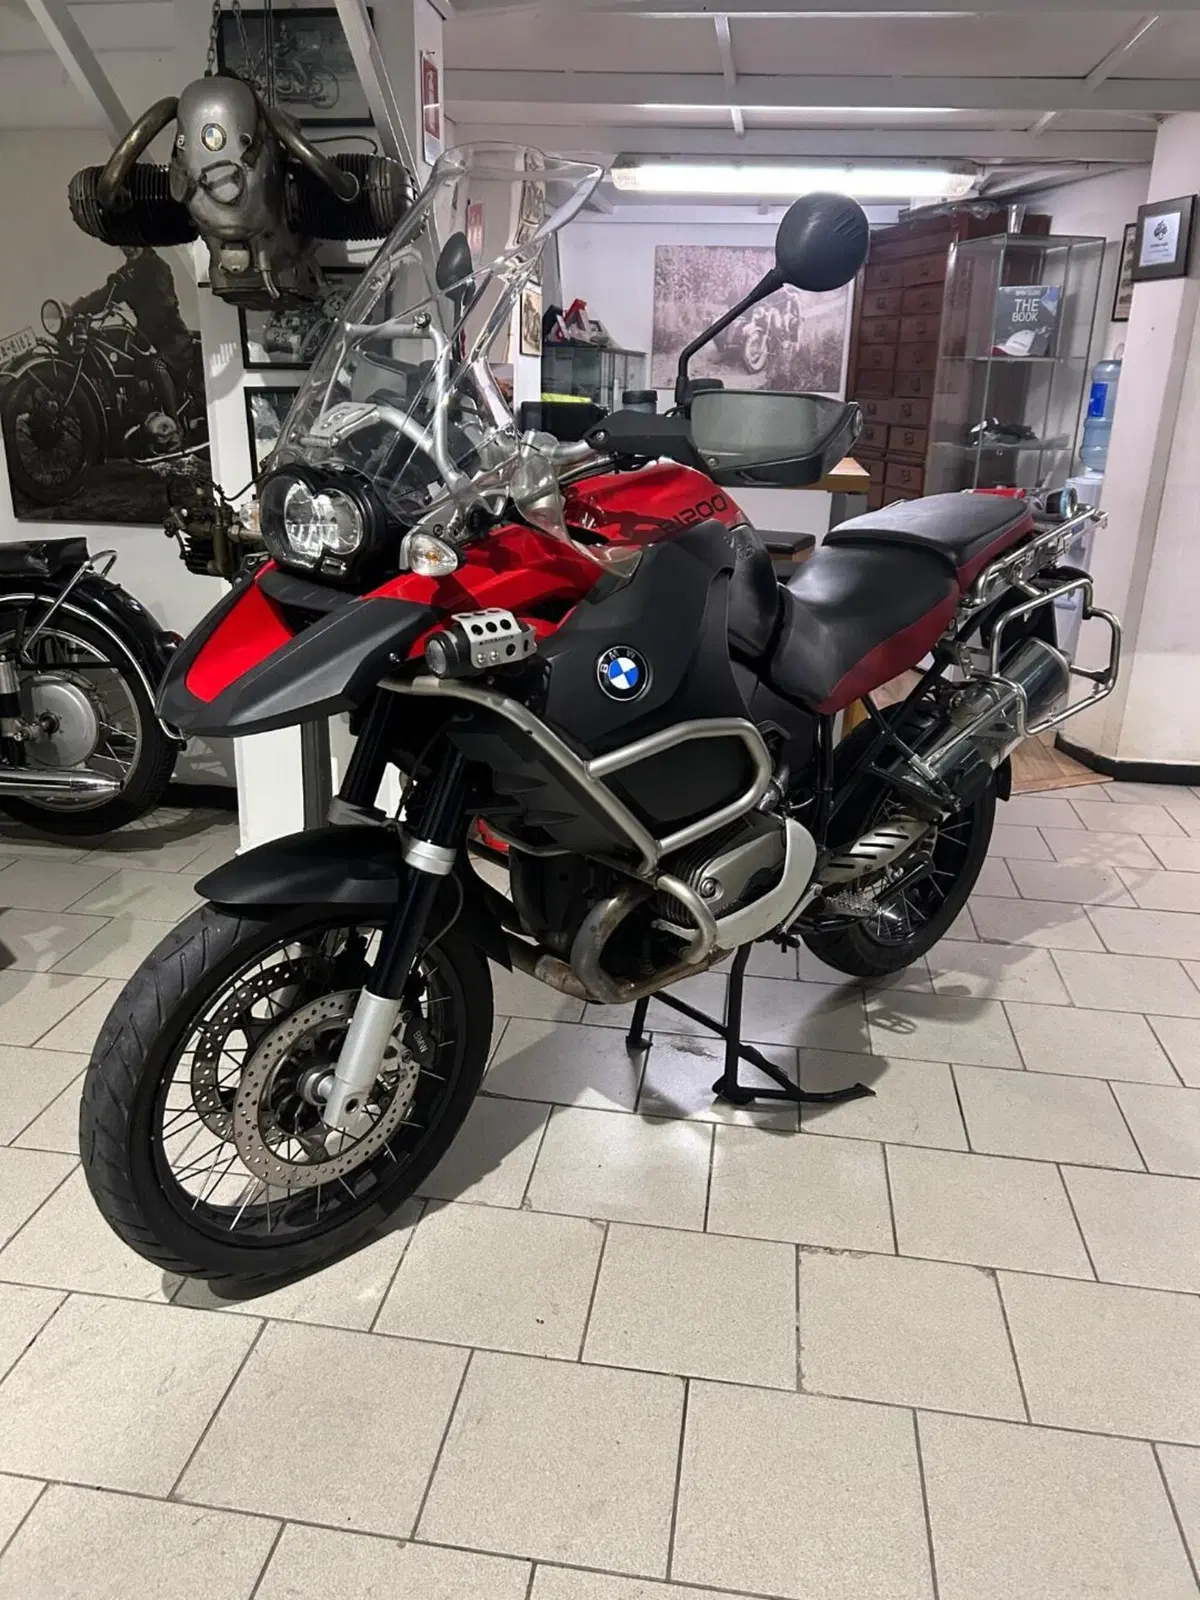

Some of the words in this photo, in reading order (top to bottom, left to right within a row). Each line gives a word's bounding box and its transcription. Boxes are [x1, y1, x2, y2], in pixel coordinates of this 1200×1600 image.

[1014, 298, 1040, 312] THE
[1011, 312, 1039, 322] BOOK
[600, 649, 637, 674] BMW
[413, 1030, 429, 1053] BMW
